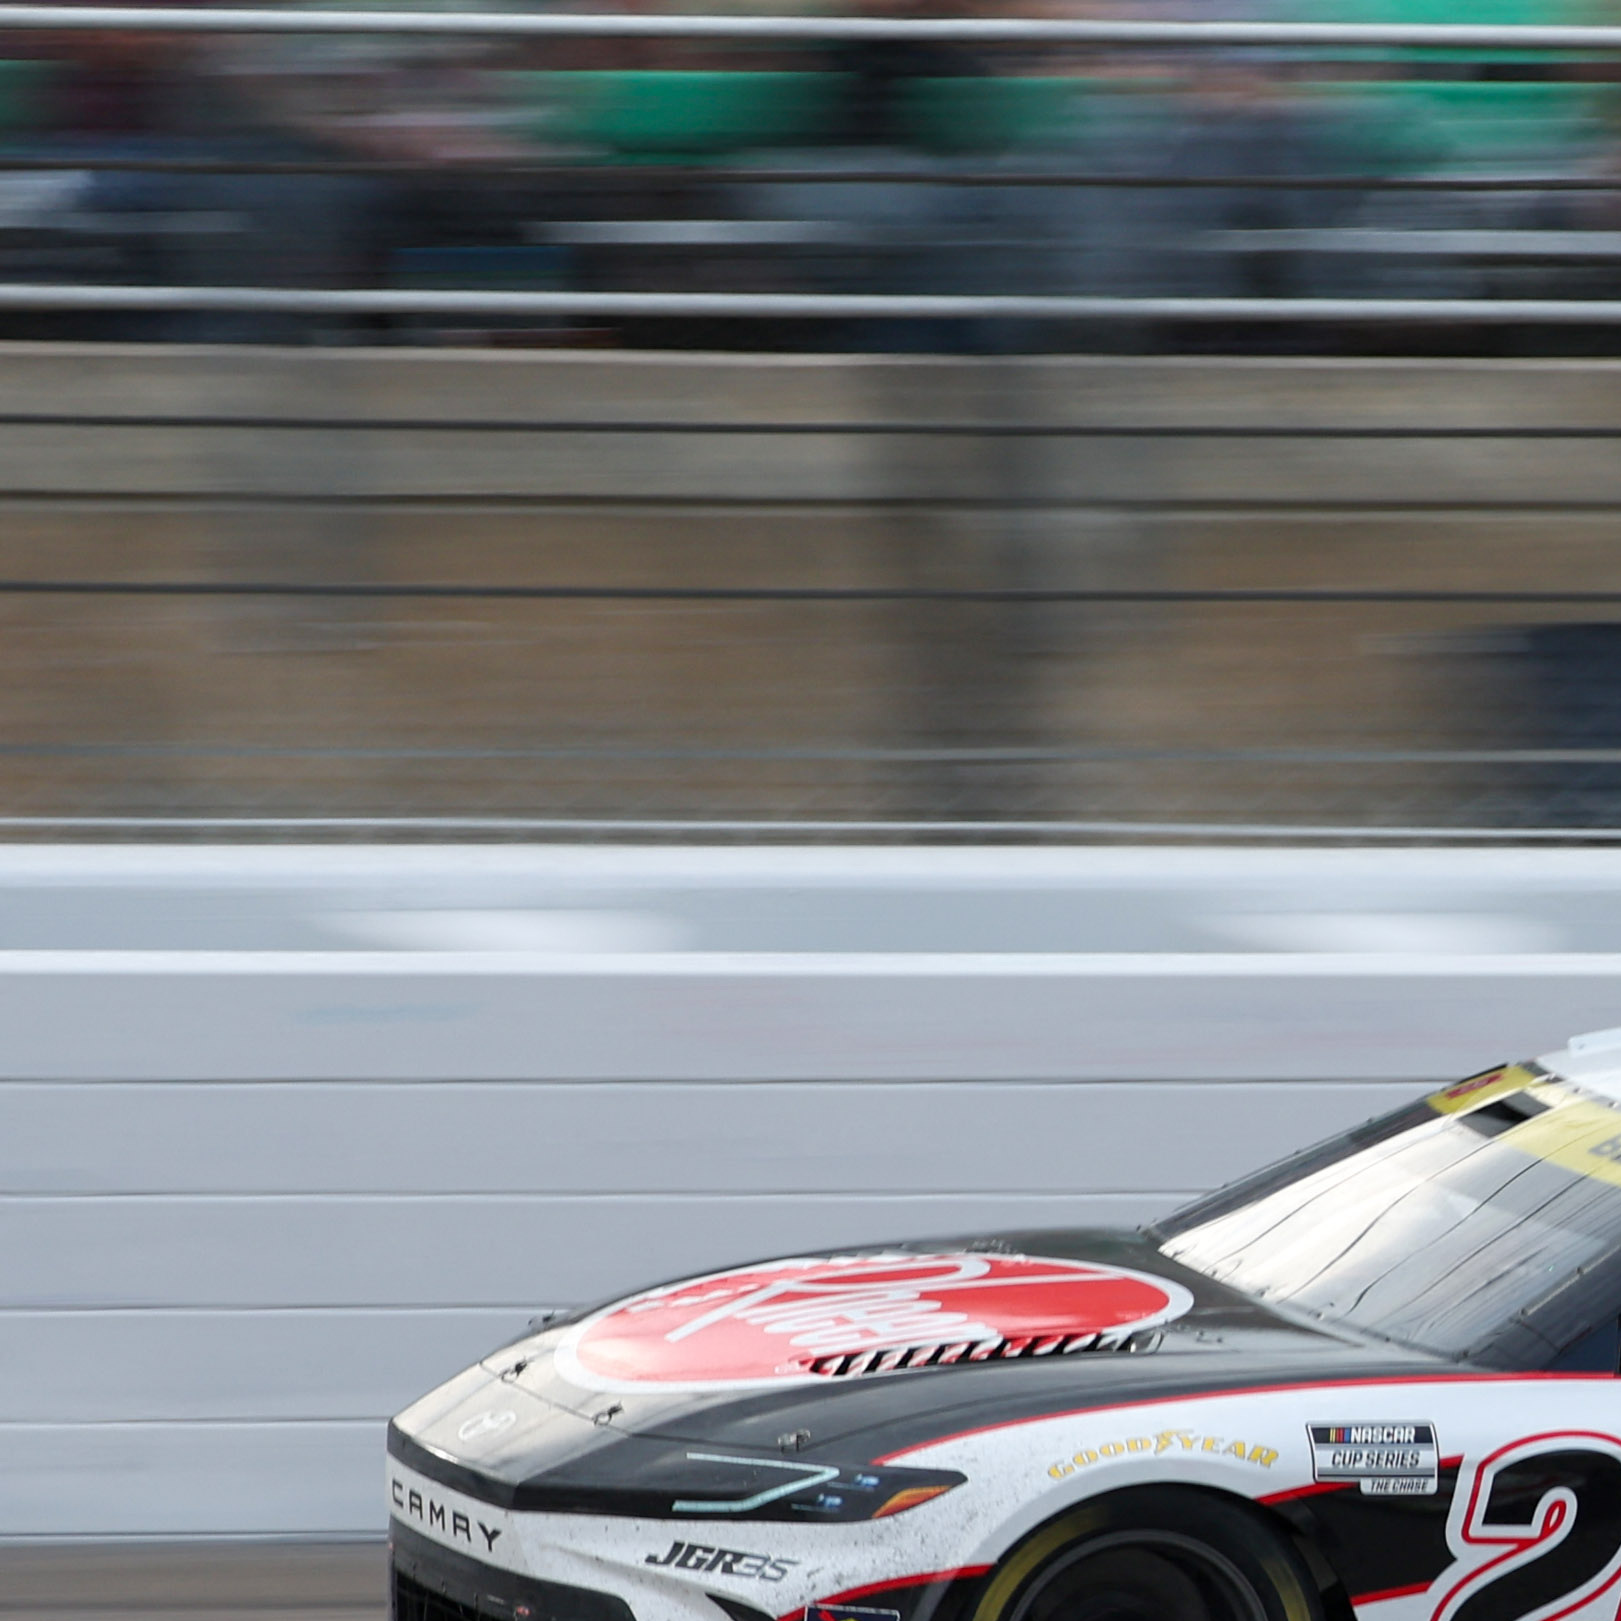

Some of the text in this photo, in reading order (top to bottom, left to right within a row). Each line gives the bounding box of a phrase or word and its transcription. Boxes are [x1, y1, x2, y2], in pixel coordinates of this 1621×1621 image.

[1351, 1427, 1415, 1443] NASCAR
[1047, 1430, 1279, 1481] GOODYEAR
[1332, 1452, 1420, 1468] CUP SERIES
[391, 1478, 502, 1553] CAMRY
